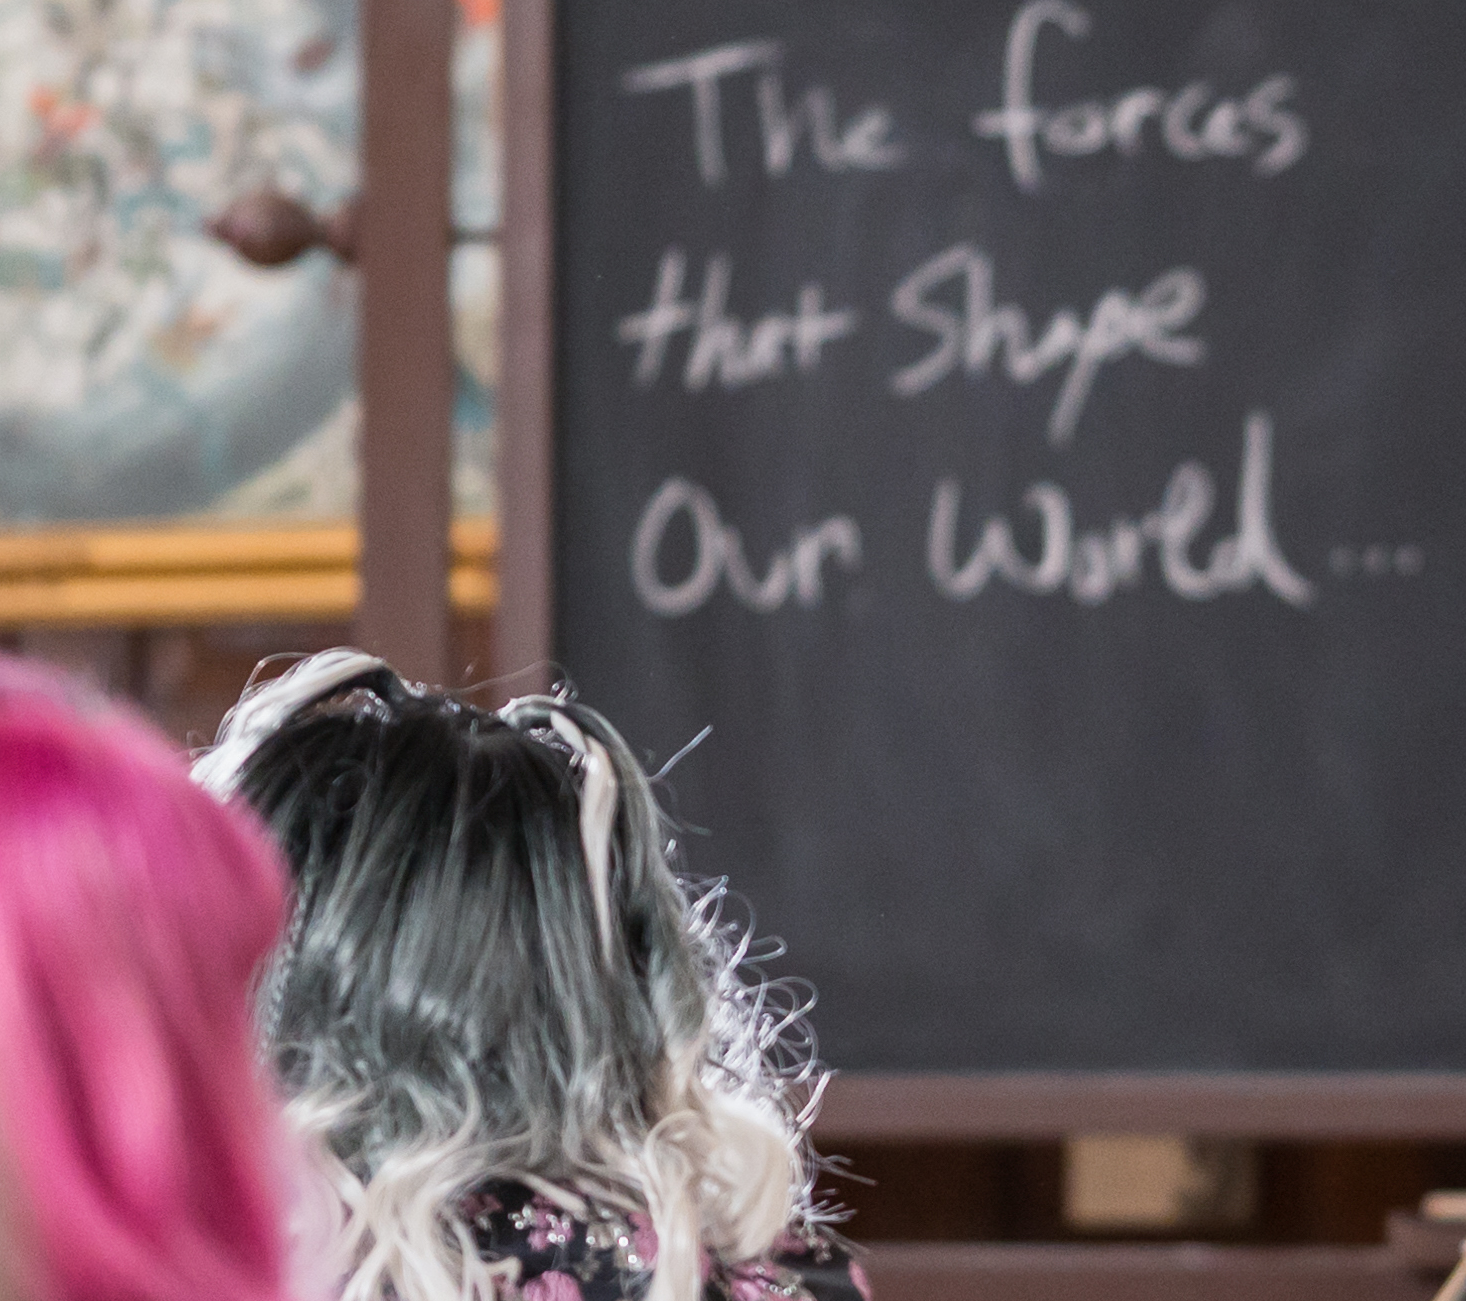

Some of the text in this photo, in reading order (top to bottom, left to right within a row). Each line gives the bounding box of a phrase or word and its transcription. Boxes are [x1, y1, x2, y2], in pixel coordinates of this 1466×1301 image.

[622, 36, 908, 188] The
[612, 240, 1214, 450] that Shape
[630, 476, 866, 620] Our
